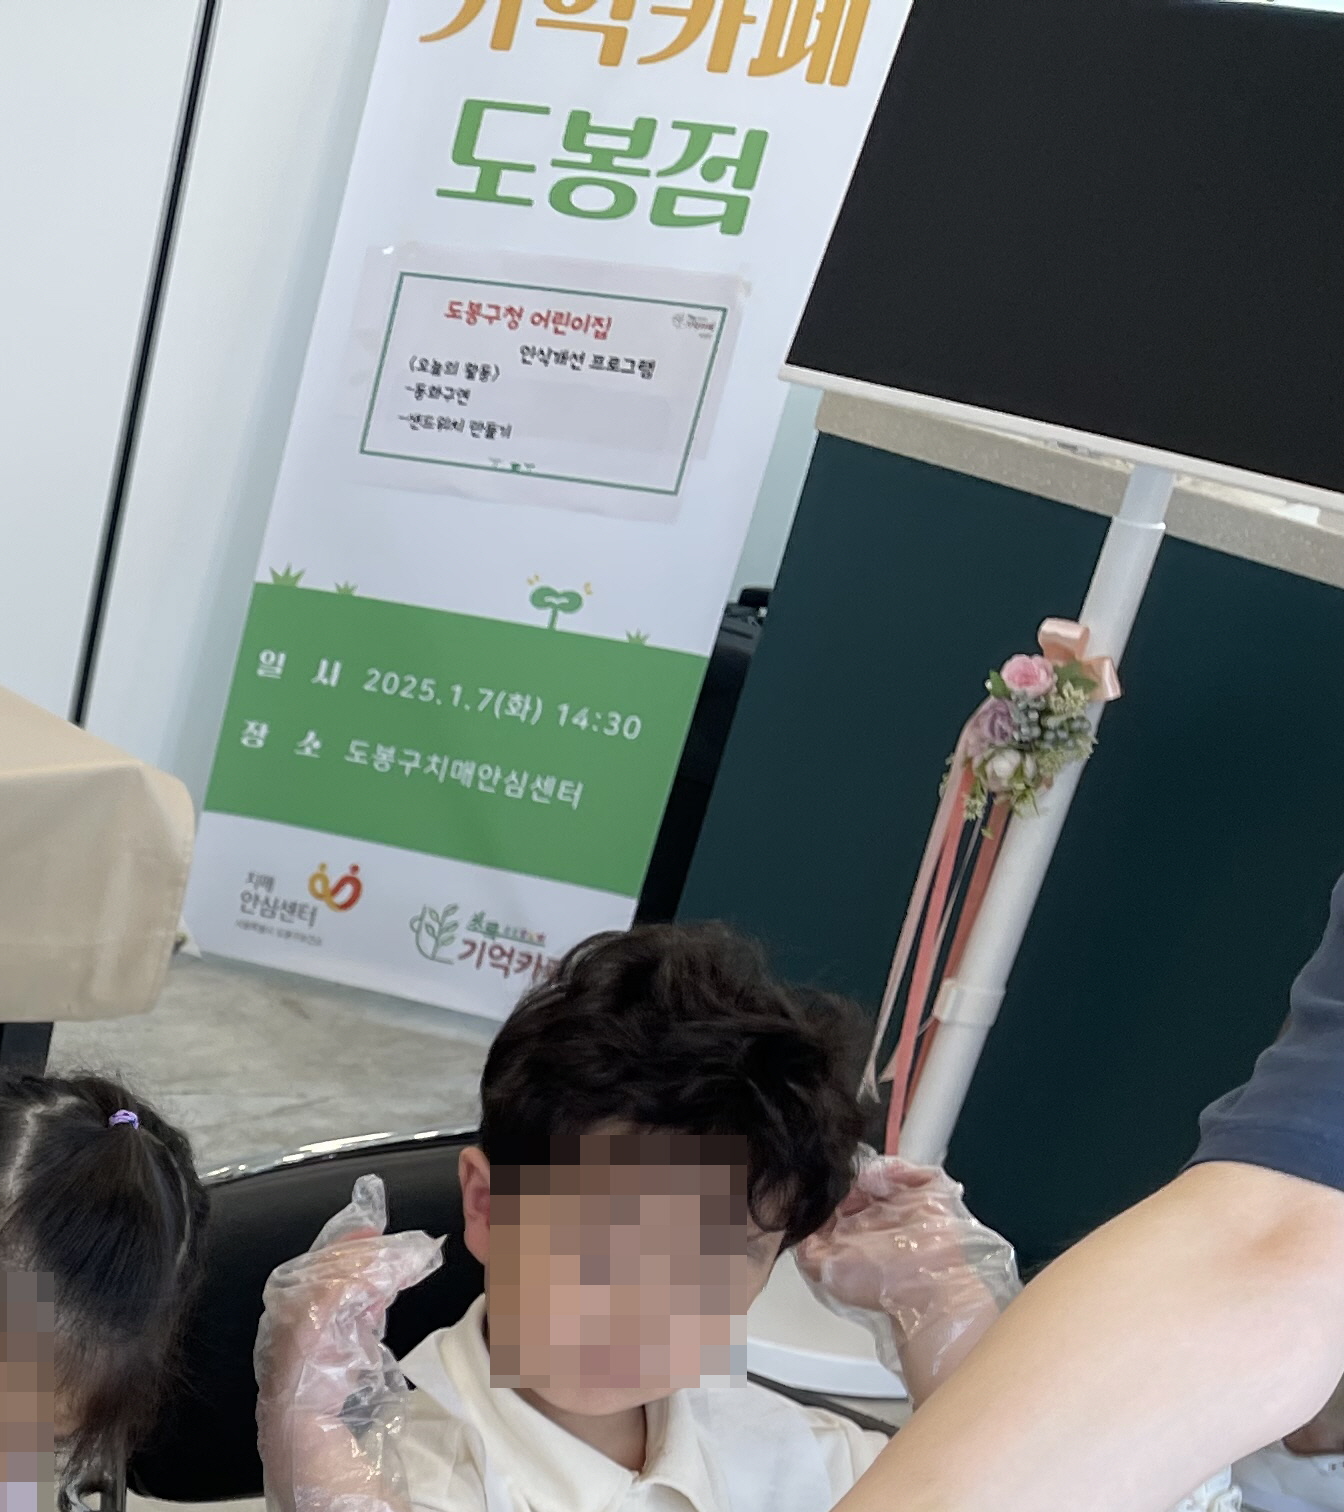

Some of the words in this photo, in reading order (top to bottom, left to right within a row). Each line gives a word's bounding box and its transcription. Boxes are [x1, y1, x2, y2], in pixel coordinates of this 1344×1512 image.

[436, 98, 769, 236] 도봉점
[444, 300, 524, 331] 도봉구청
[530, 309, 612, 341] 어린이집
[588, 352, 656, 380] 프로그램
[255, 649, 287, 679] 일
[311, 658, 343, 688] 시
[363, 667, 544, 726] 2025.1.7(화)
[557, 702, 643, 742] 14:30
[240, 719, 270, 749] 장
[294, 728, 323, 759] 소
[344, 738, 585, 811] 도봉구치매안심센터
[240, 889, 318, 928] 안심센터
